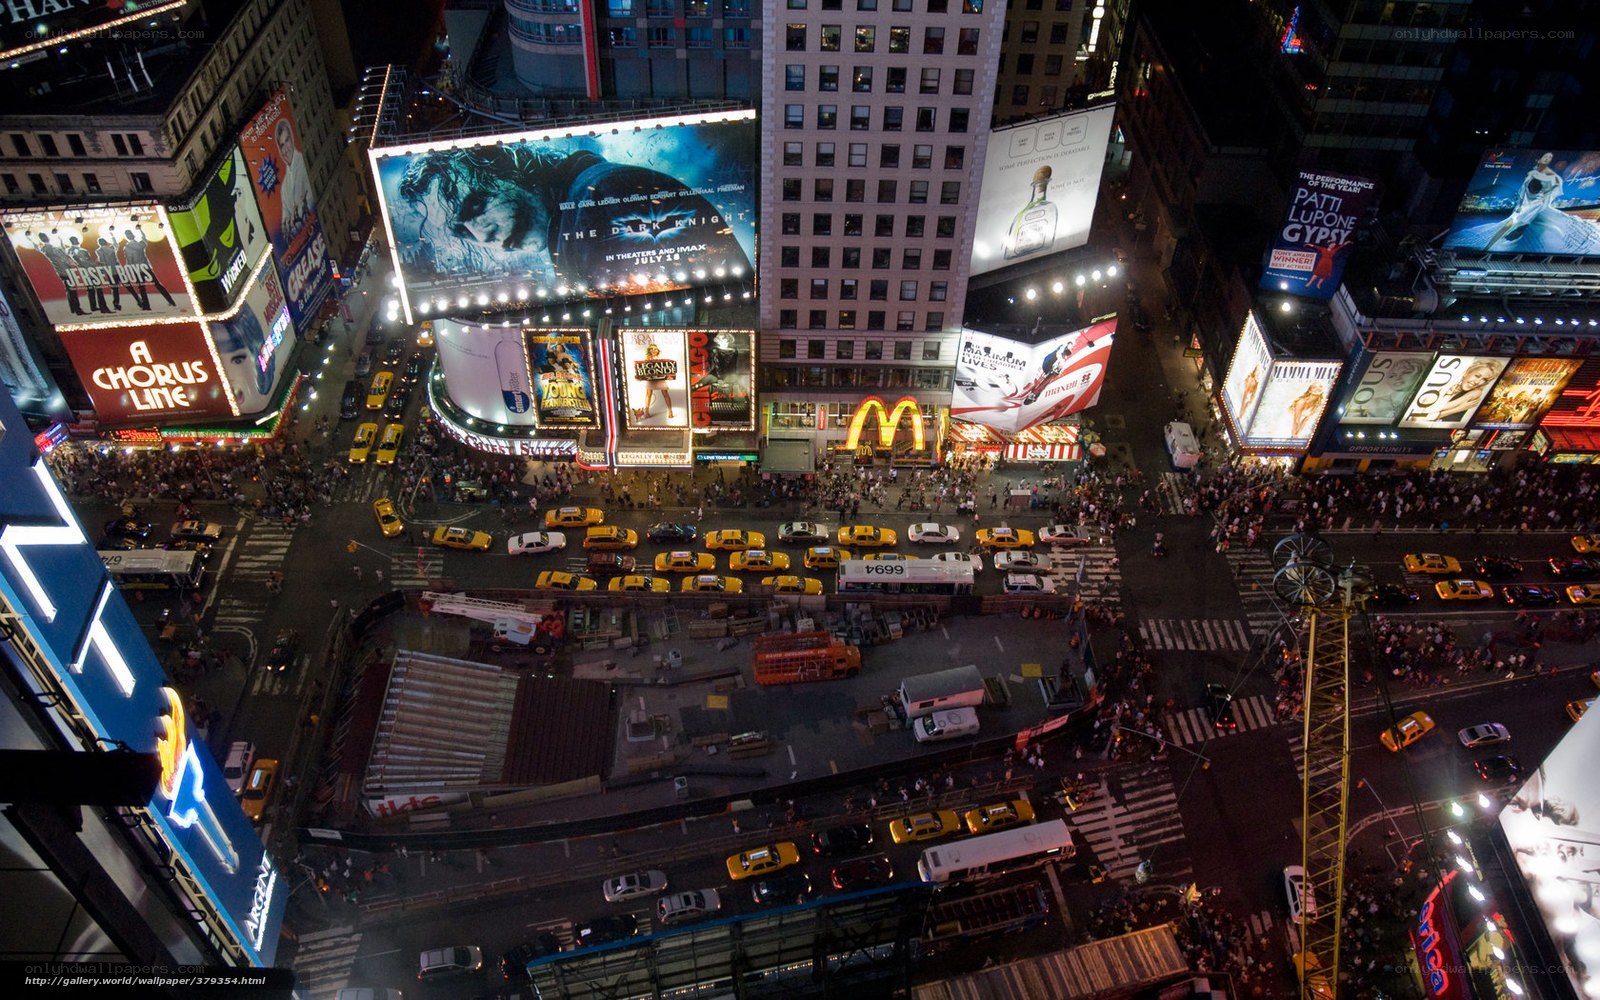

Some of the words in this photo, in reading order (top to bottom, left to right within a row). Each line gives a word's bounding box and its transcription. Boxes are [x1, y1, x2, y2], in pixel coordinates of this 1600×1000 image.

[1017, 155, 1052, 168] PERFECTION
[1300, 172, 1315, 181] THE
[1315, 175, 1374, 190] PERFORMANCE
[1321, 182, 1337, 190] THE
[1339, 185, 1361, 194] YEAR!
[559, 203, 576, 211] BALE
[597, 197, 621, 206] LEDGER
[623, 195, 648, 203] OLDMAN
[650, 192, 677, 200] ECKHART
[679, 188, 715, 197] GYLLENHAAL
[717, 185, 745, 193] FREEMAN
[1295, 188, 1343, 212] PATTI
[562, 229, 597, 241] THE
[612, 221, 661, 236] DARK
[675, 212, 747, 228] KNIGHT
[1282, 223, 1352, 245] GYPSY
[616, 250, 657, 261] THEATERS
[659, 247, 676, 256] AND
[676, 243, 707, 253] IMAX
[634, 256, 662, 265] JULY
[665, 254, 681, 262] 18
[1273, 255, 1314, 265] WINNER!
[65, 265, 116, 287] JERSEY
[117, 263, 153, 284] BOYS
[288, 232, 326, 302] GREASE
[129, 341, 152, 364] A
[964, 343, 1026, 367] MAXIMUM
[636, 361, 676, 369] LEGALLY
[637, 367, 677, 376] BLONDE
[962, 357, 997, 371] LIVES
[92, 361, 208, 390] CHORUS
[541, 382, 586, 400] YOUNG
[1406, 357, 1461, 421] TOUS
[128, 386, 190, 411] LINE
[541, 399, 592, 411] FRANKENSTEIN
[1348, 445, 1413, 453] OPPORTUNITY
[865, 565, 904, 575] 6694
[244, 850, 273, 943] ARGENT
